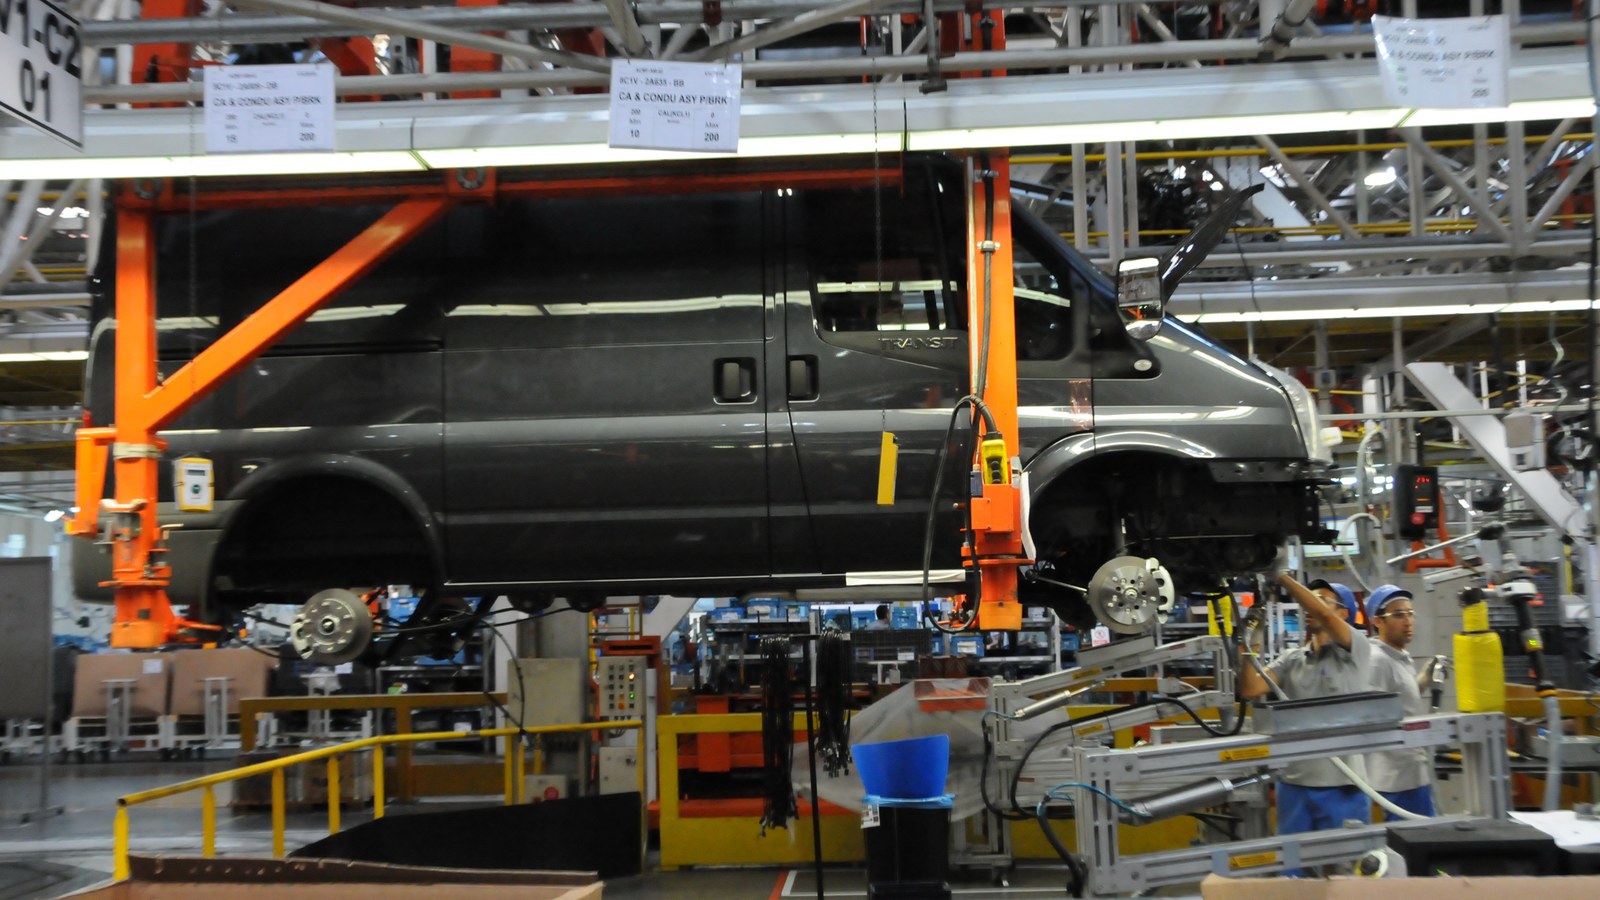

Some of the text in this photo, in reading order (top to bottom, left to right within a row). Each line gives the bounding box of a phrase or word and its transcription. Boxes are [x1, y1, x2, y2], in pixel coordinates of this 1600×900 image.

[19, 59, 52, 122] 01
[619, 91, 728, 105] CA & CONDU ASY P/BRK
[630, 129, 640, 138] 10
[704, 132, 720, 142] 200
[877, 336, 960, 350] TRANSIT
